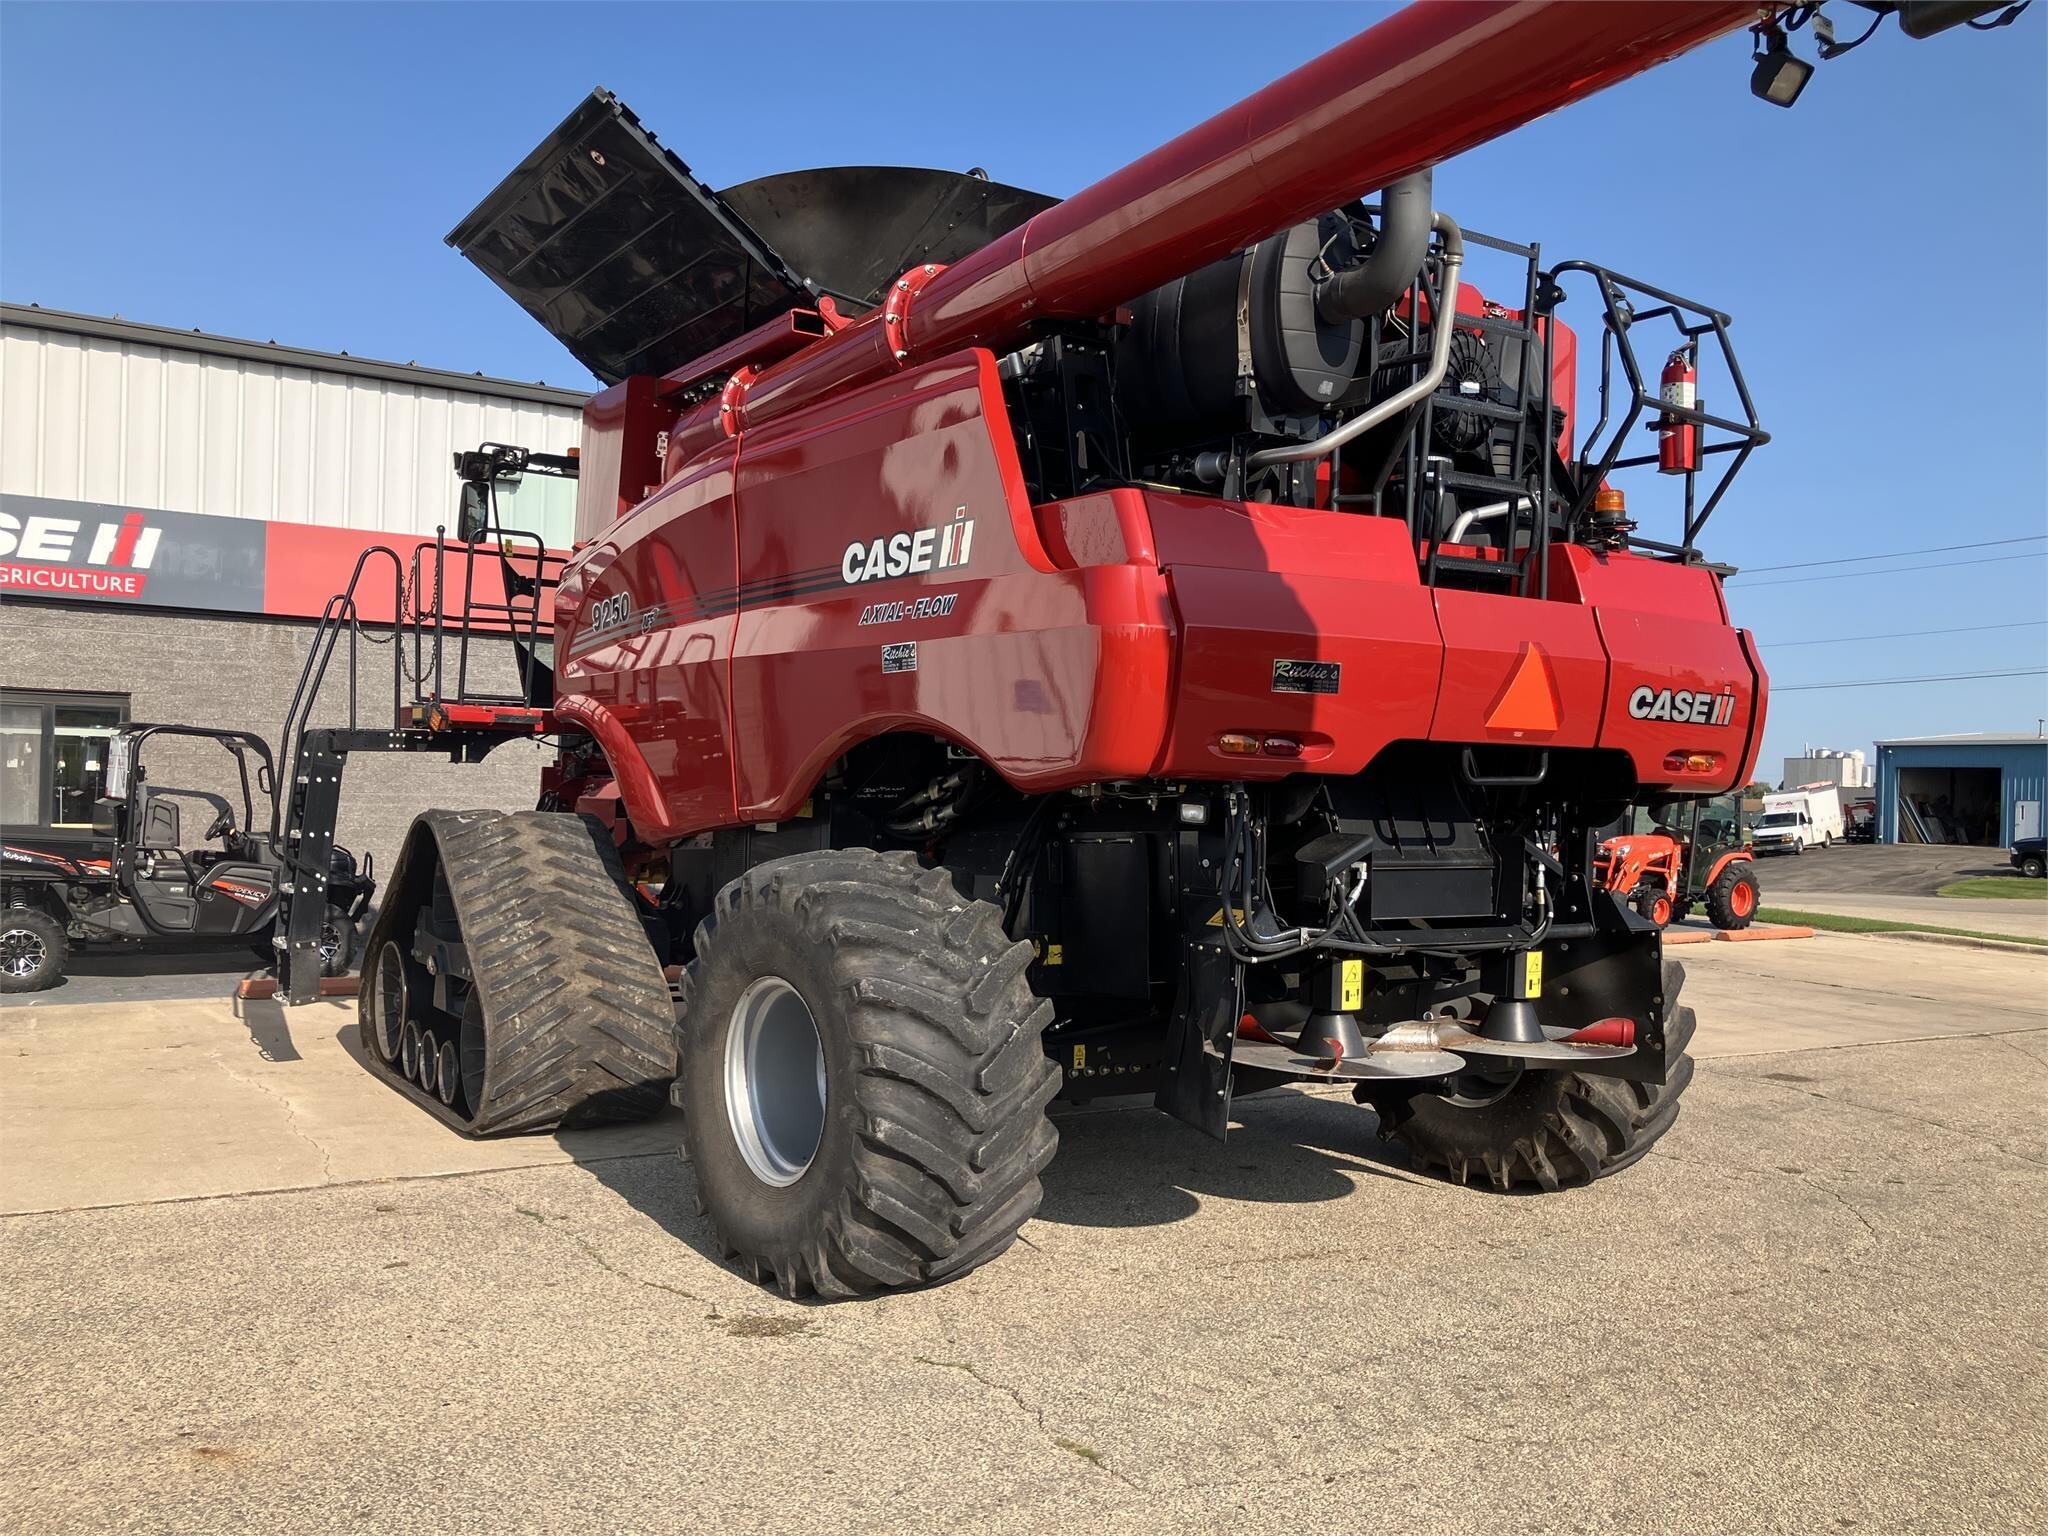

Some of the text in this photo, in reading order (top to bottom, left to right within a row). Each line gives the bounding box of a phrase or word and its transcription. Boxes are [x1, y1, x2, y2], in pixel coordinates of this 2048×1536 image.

[842, 506, 974, 584] CASE IH
[0, 567, 136, 593] GRICULTURE
[592, 591, 630, 632] 9250
[858, 594, 958, 625] AXIAL-FLOW
[883, 645, 915, 660] Ritchie's
[1275, 661, 1338, 679] Ritchie's
[1628, 685, 1712, 723] CASE
